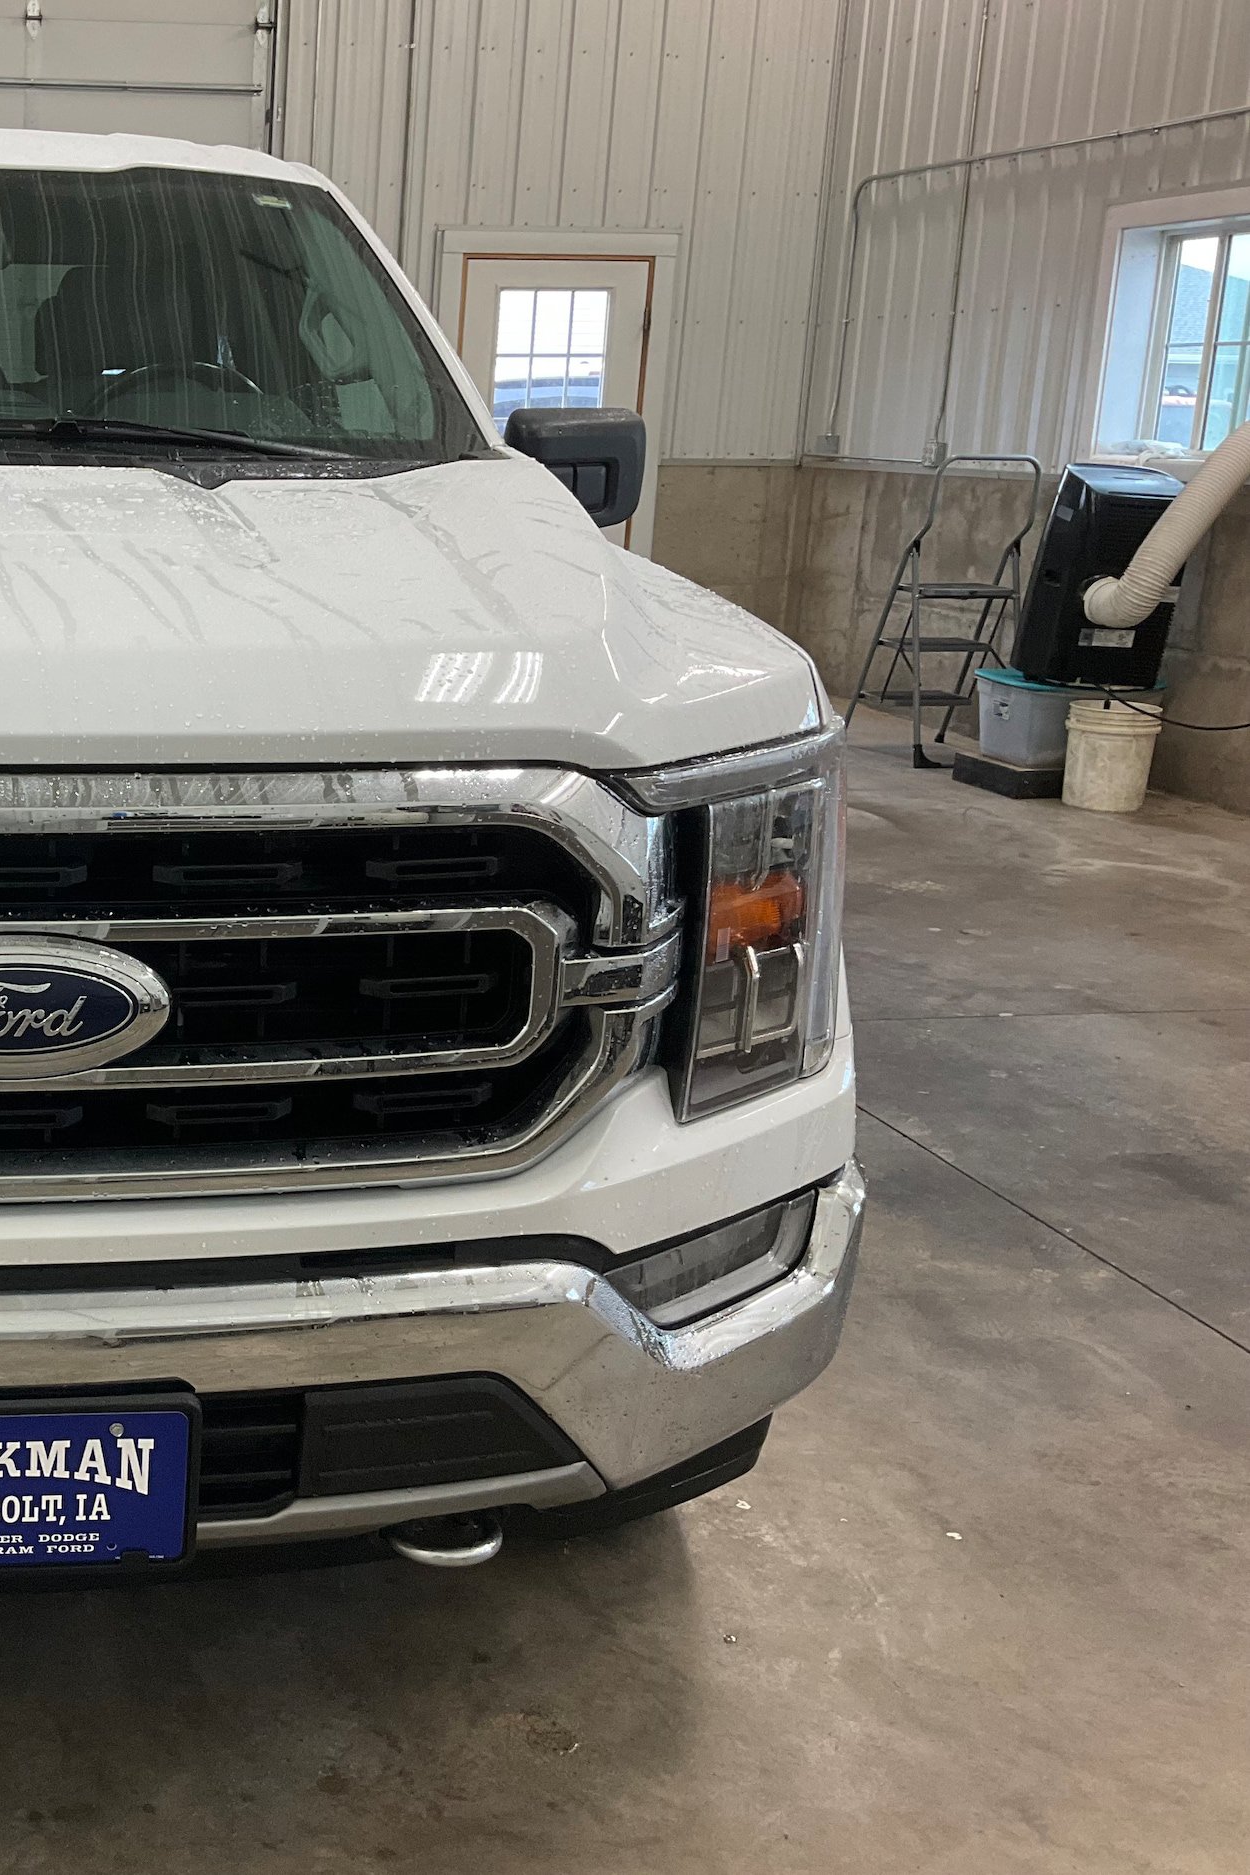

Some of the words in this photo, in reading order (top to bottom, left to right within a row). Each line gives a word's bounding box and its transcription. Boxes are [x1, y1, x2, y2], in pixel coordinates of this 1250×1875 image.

[75, 1493, 111, 1521] IA
[38, 1533, 100, 1543] DODGE
[46, 1543, 95, 1554] FORD
